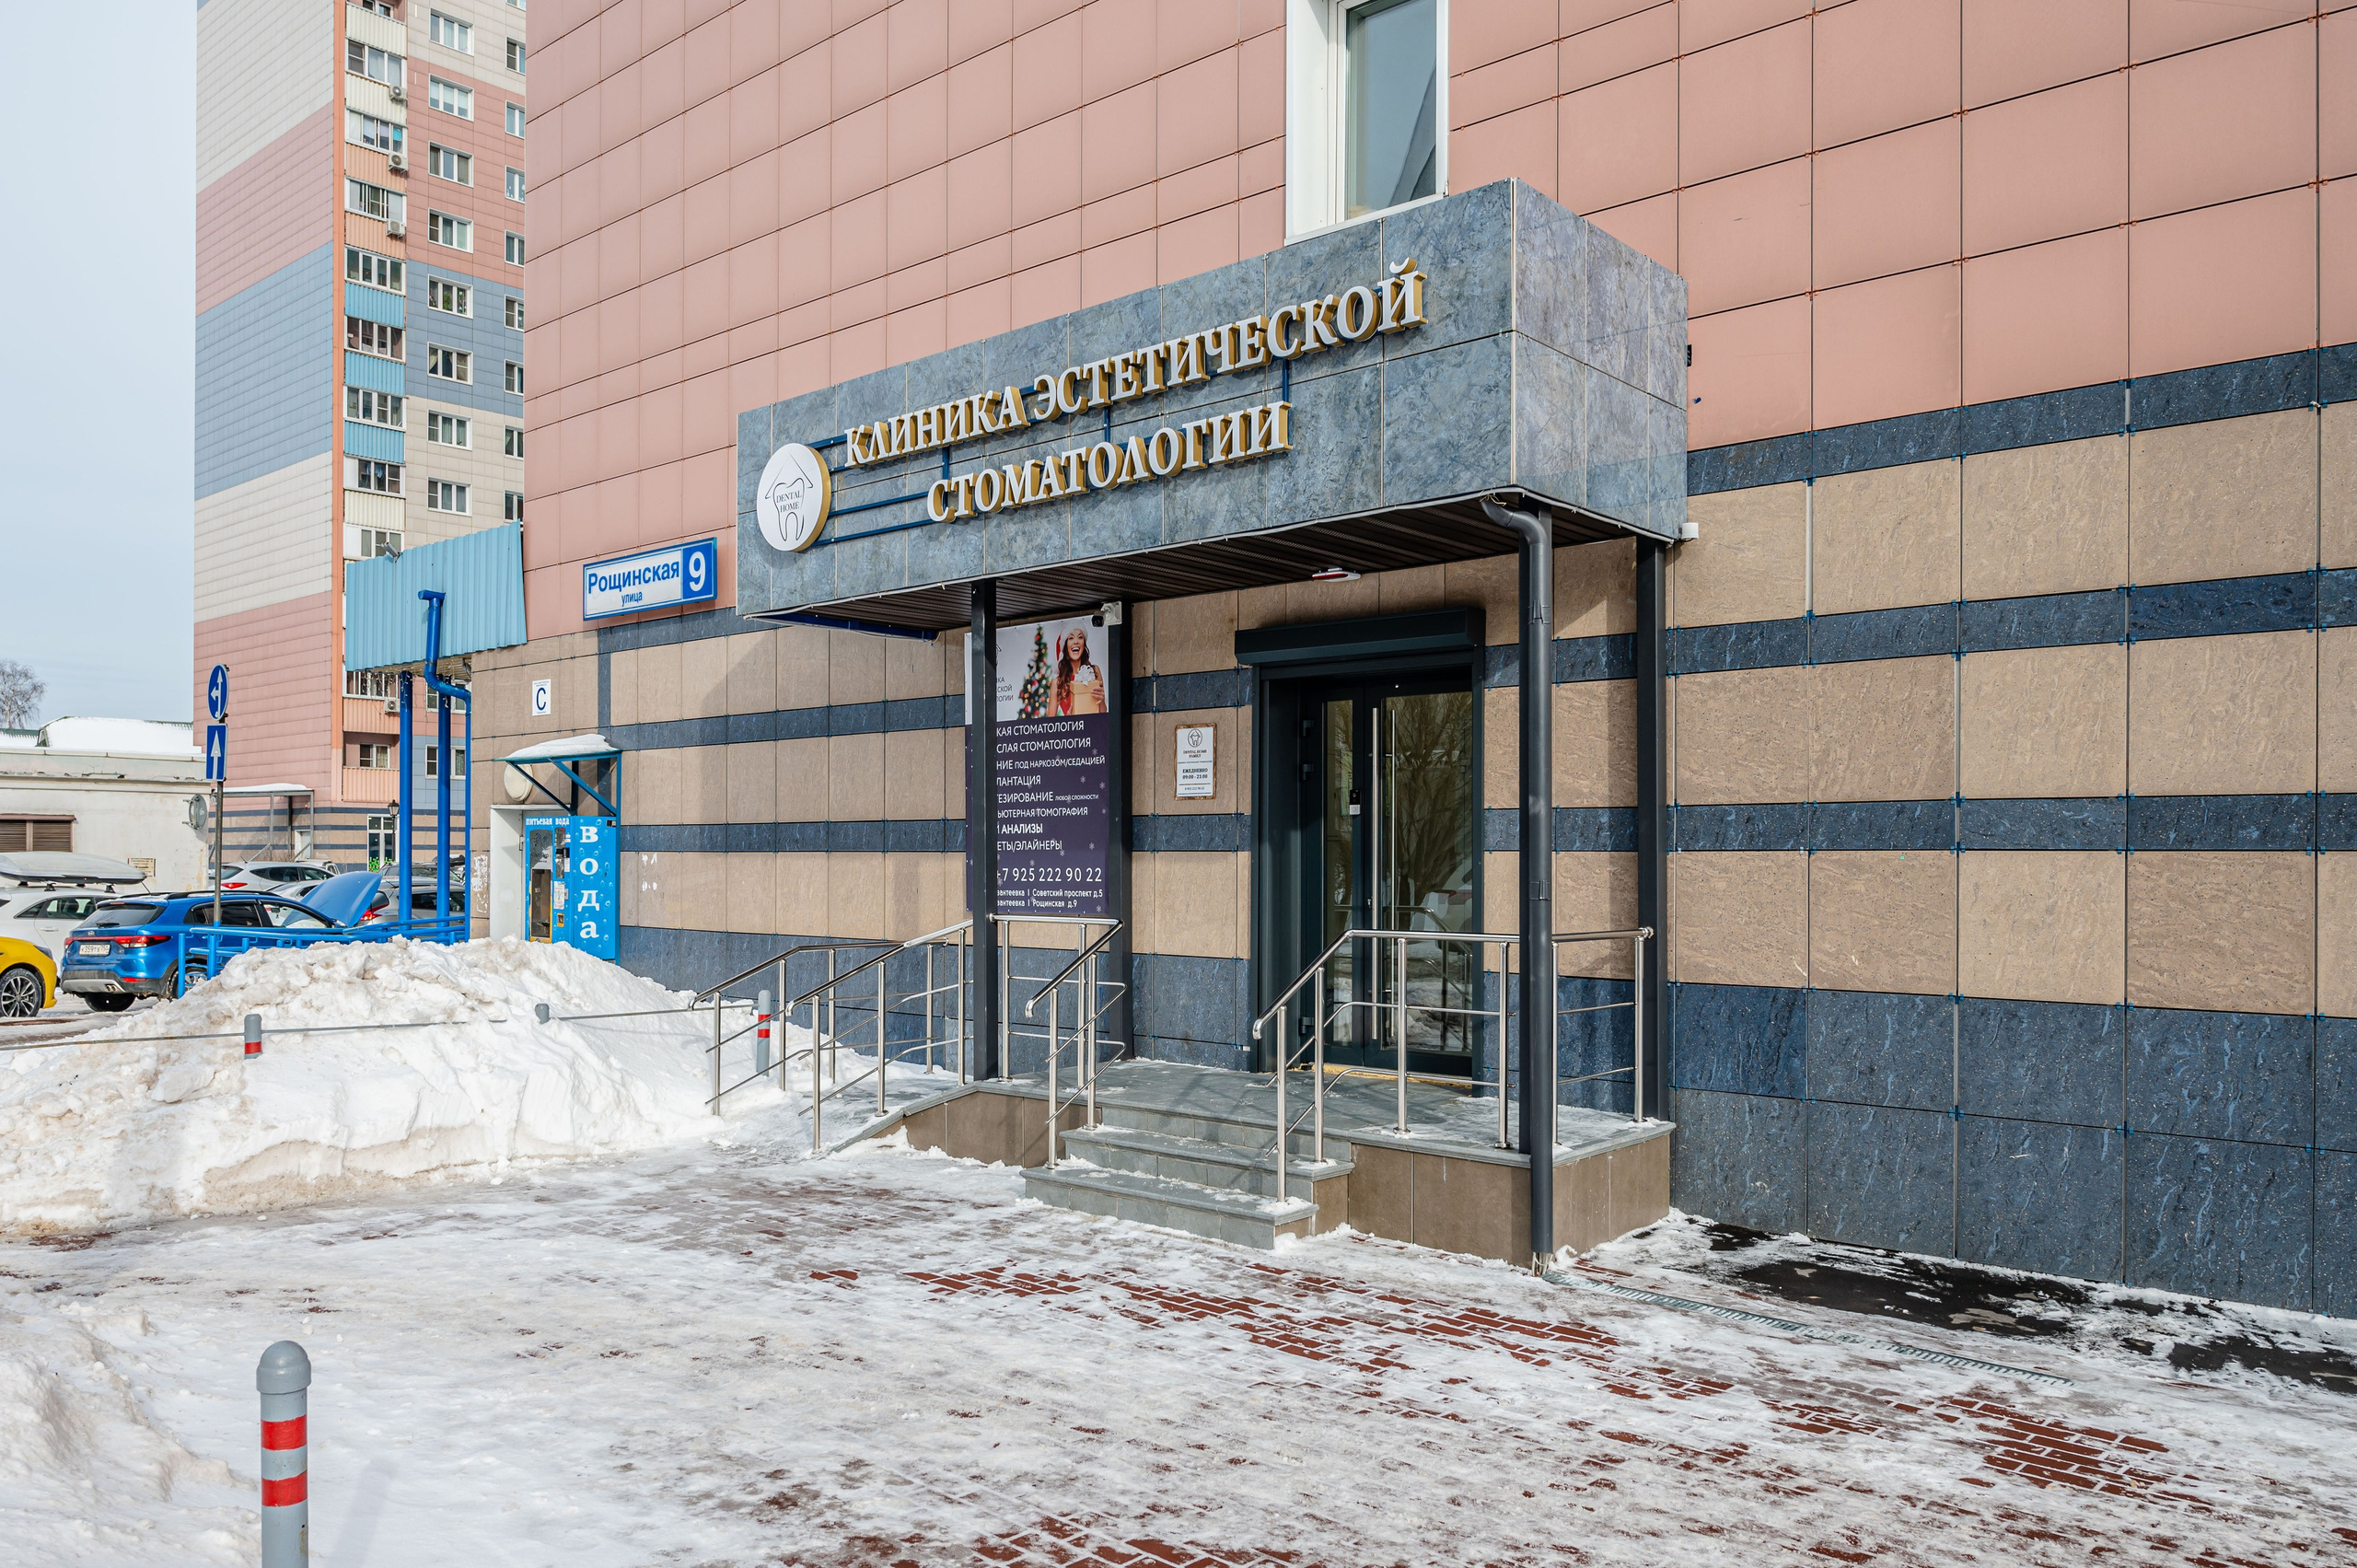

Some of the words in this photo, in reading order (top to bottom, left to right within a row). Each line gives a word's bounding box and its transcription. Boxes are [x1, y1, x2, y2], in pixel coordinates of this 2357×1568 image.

[843, 385, 1029, 469] КЛИНИКА
[1033, 257, 1428, 422] ЭСТЕТИЧЕСКОЙ
[926, 401, 1294, 524] СТОМАТОЛОГИИ
[776, 490, 802, 504] DENTAL
[780, 501, 799, 513] HOME
[587, 561, 679, 594] Рощинская
[688, 551, 706, 592] 9
[621, 590, 643, 607] улица
[996, 726, 1011, 737] КАЯ
[1013, 720, 1085, 736] СТОМАТОЛОГИЯ
[996, 742, 1017, 753] СЛАЯ
[1019, 737, 1091, 752] СТОМАТОЛОГИЯ
[996, 760, 1013, 770] НИЕ
[1029, 755, 1106, 769] НАРКОЗОМ/СЕДАЦИЕЙ
[996, 774, 1041, 787] ЛАНТАЦИЯ
[997, 791, 1053, 804] ЕЗИРОВАНИЕ
[997, 808, 1036, 819] ЬЮТЕРНАЯ
[1036, 807, 1088, 818] ТОМОГРАФИЯ
[1001, 823, 1043, 834] АНАЛИЗЫ
[997, 838, 1062, 853] ЕТЫ/ЭЛАЙНЕРЫ
[1012, 867, 1036, 882] 925
[1039, 867, 1062, 882] 222
[1065, 867, 1082, 882] 90
[1086, 867, 1102, 882] 22
[997, 889, 1025, 898] вантеевка
[1032, 889, 1063, 898] Советский
[1063, 890, 1093, 899] проспект
[1032, 900, 1065, 909] Рощинская
